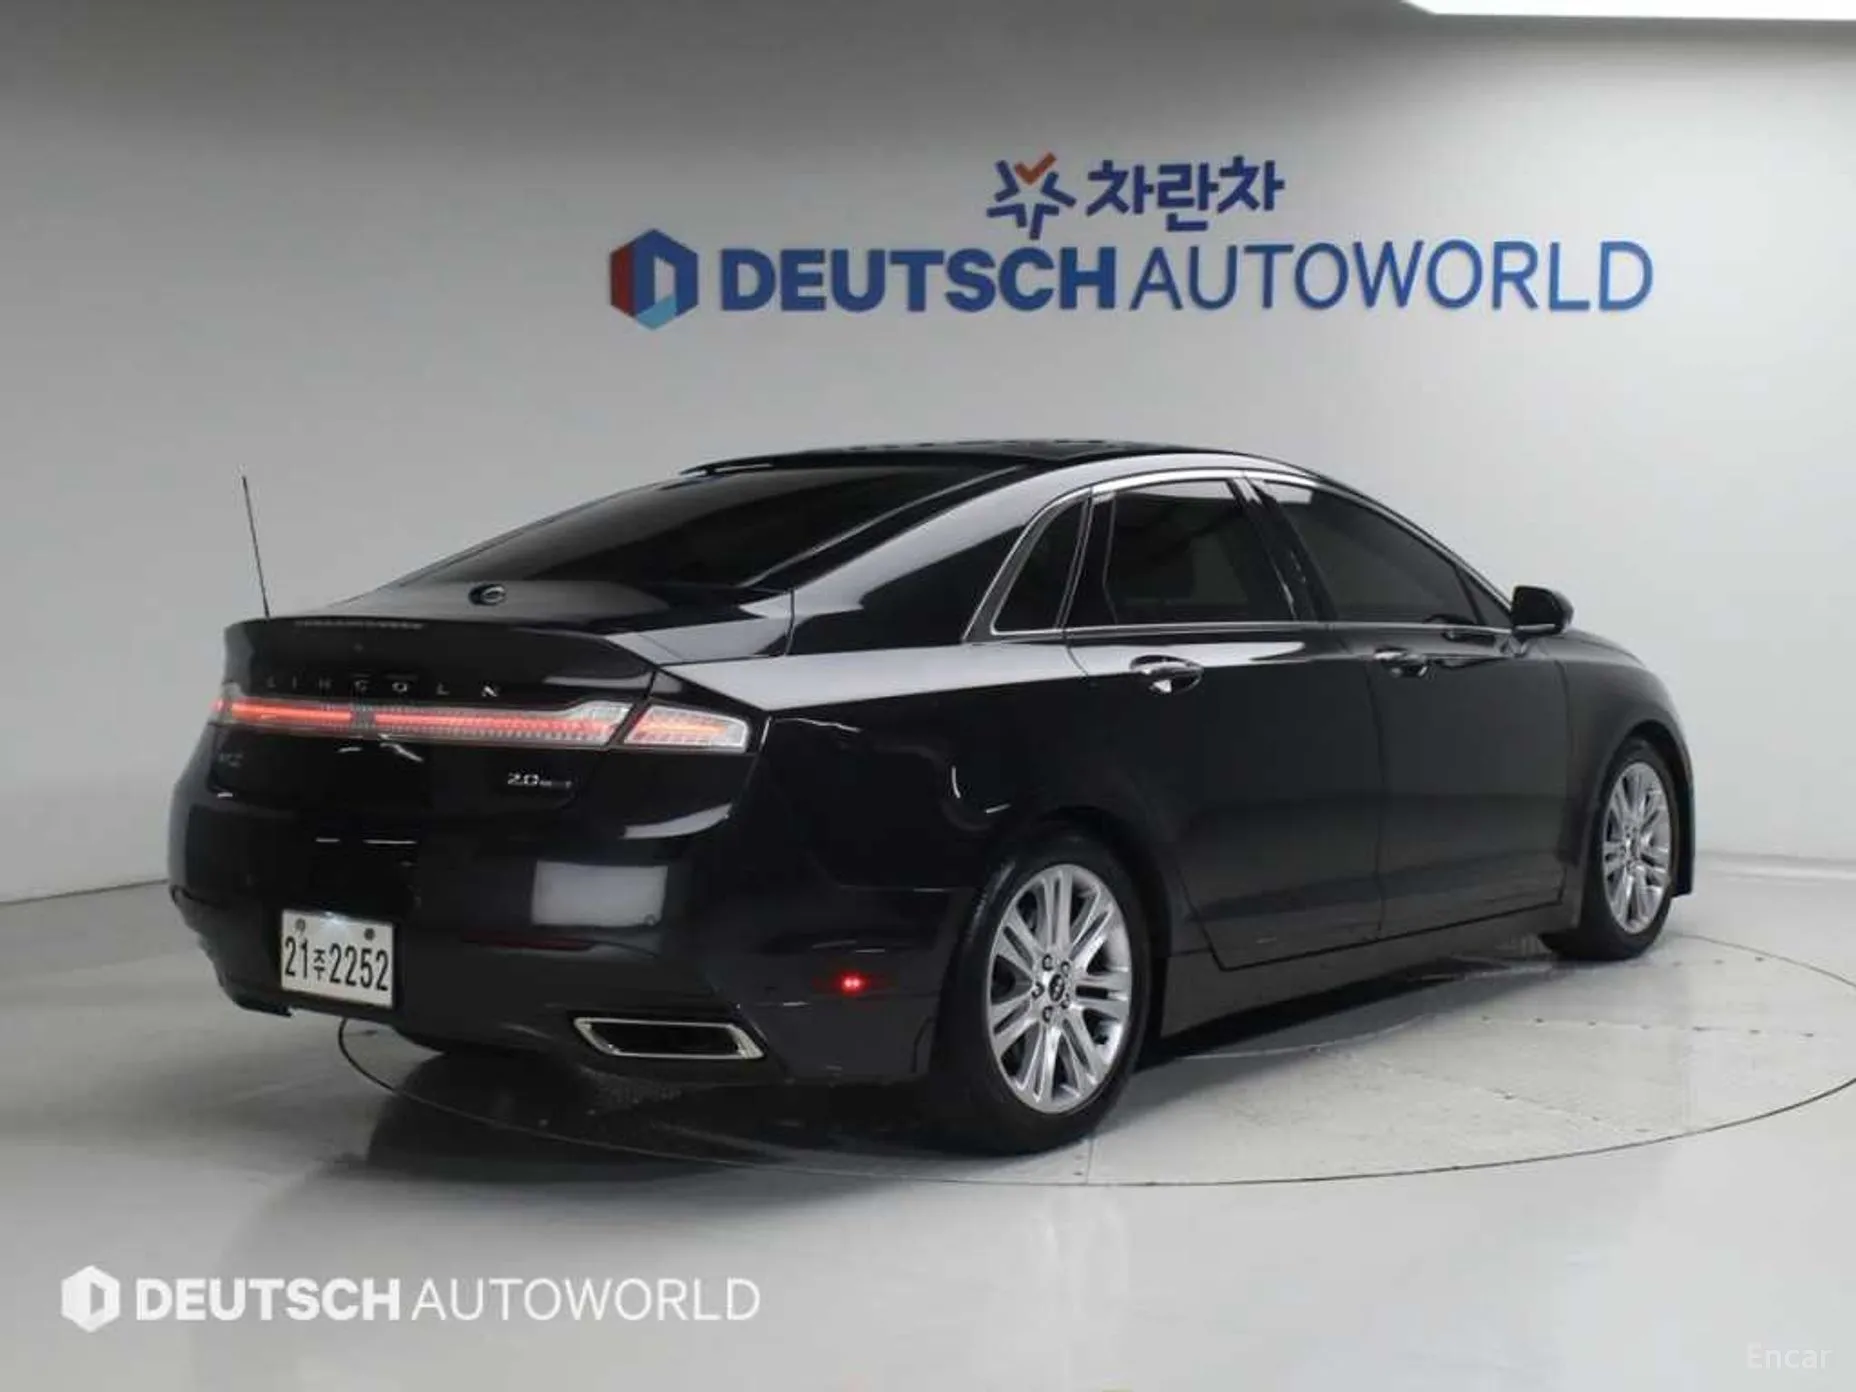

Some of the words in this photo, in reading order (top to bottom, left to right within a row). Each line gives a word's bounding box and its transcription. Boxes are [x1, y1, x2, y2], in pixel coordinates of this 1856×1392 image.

[1086, 155, 1285, 232] 차란차
[720, 246, 1116, 312] DEUTSCH
[1129, 239, 1654, 312] AUTOWORLD
[284, 935, 390, 991] 21주2252
